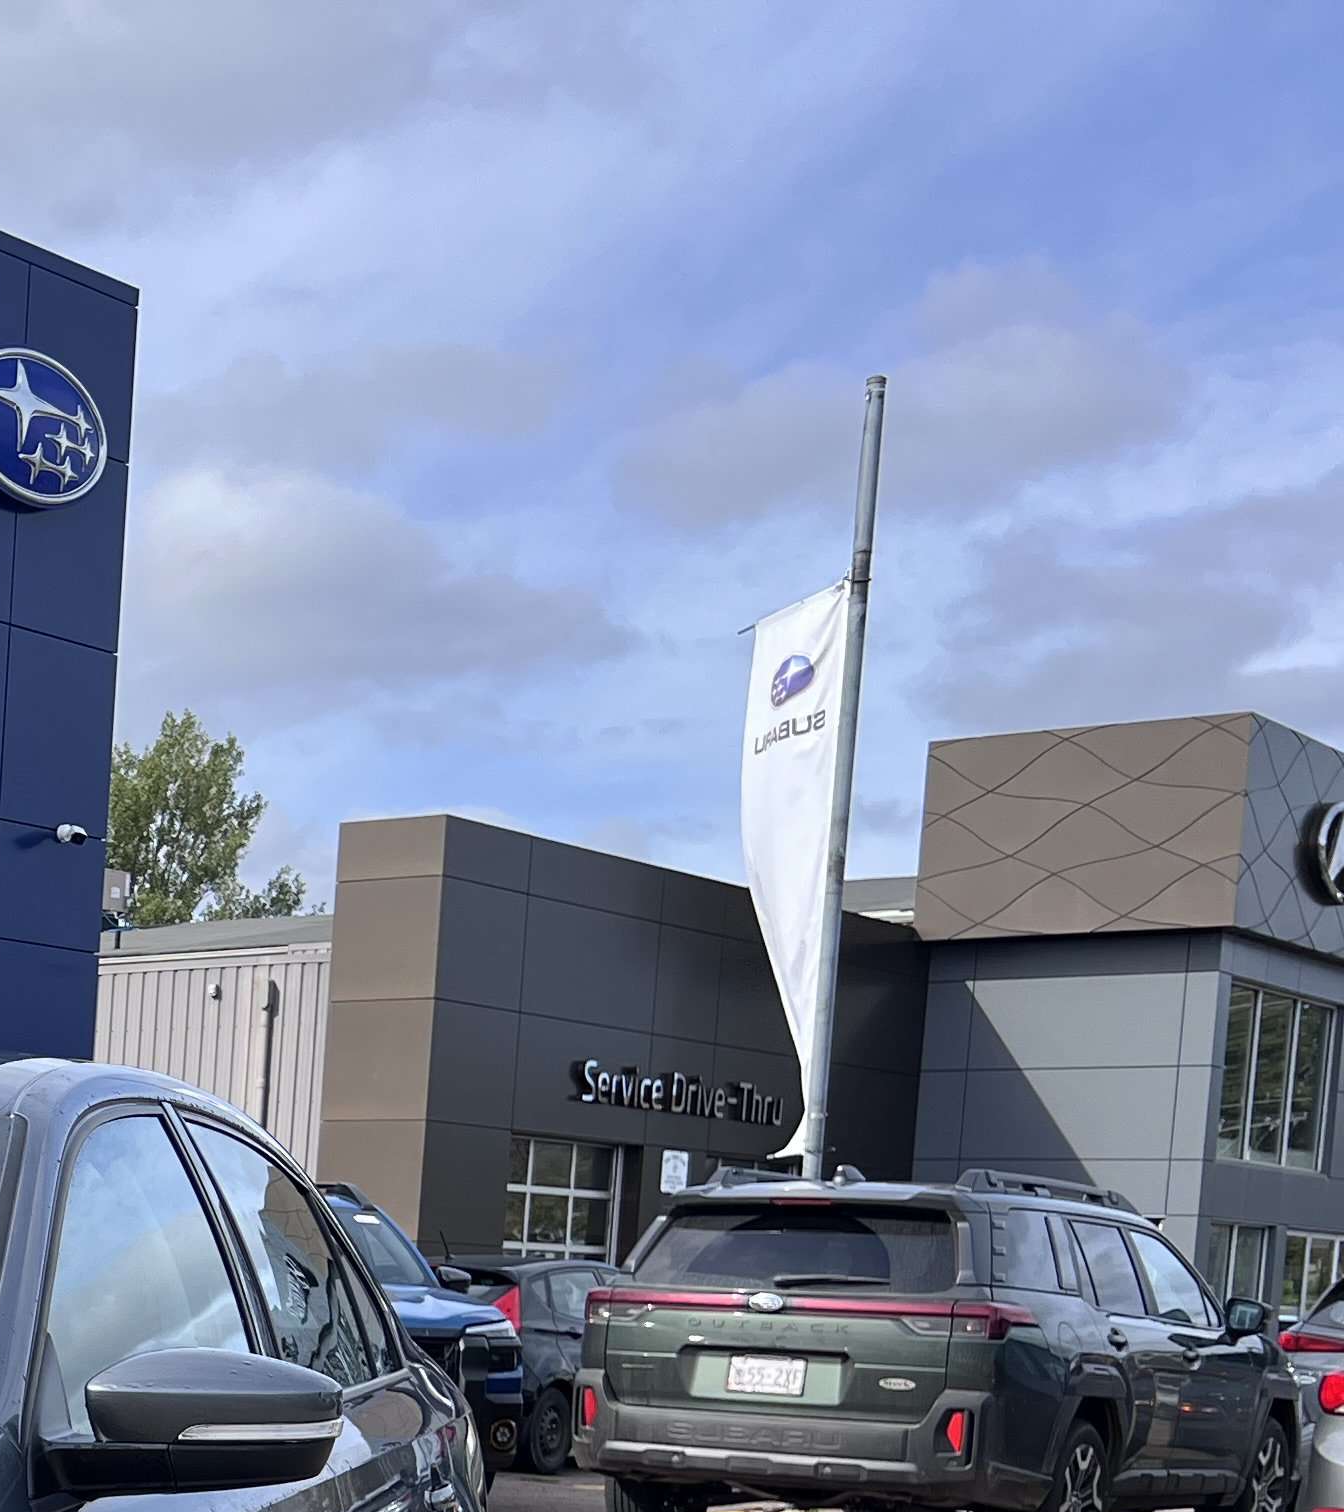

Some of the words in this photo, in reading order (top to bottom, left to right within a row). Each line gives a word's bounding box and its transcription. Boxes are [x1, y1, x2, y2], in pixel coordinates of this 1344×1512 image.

[582, 1059, 663, 1110] Service
[671, 1071, 783, 1127] Drive-Thru
[687, 1318, 849, 1335] OUTBACK
[667, 1421, 846, 1450] SUBARU
